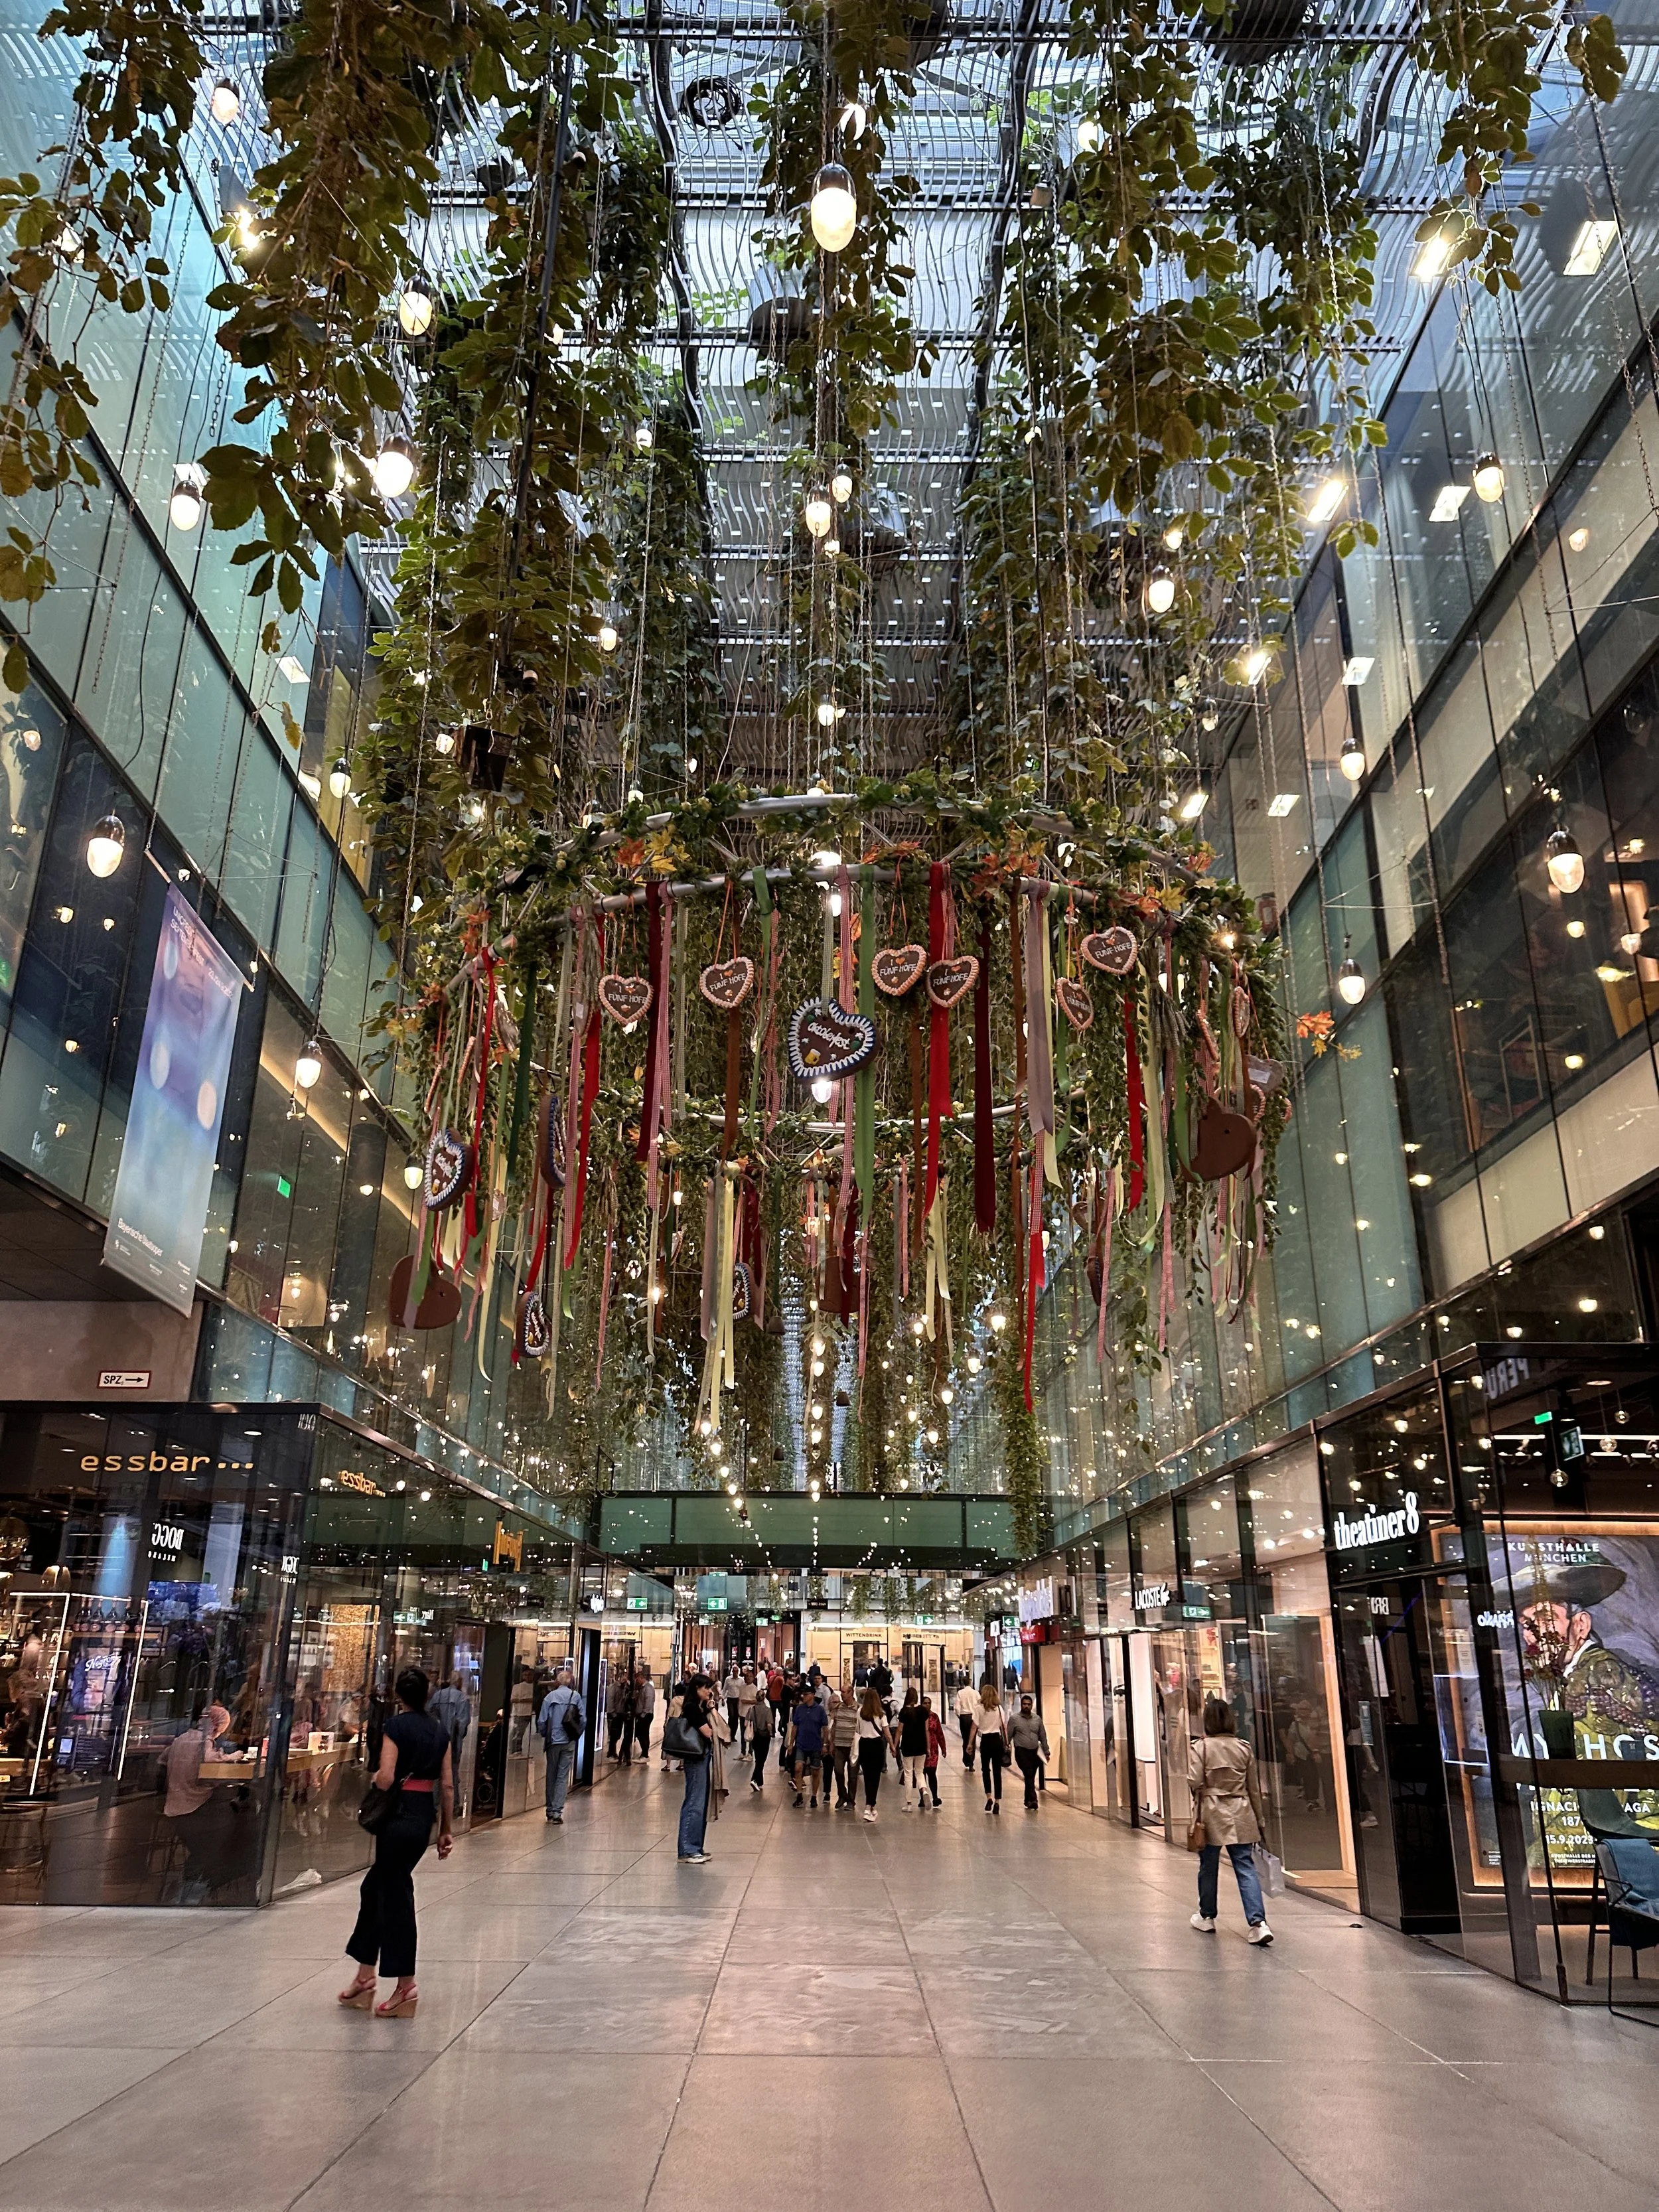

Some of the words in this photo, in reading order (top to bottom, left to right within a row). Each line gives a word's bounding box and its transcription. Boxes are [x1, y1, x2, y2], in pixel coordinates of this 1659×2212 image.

[1135, 1585, 1161, 1610] LACOSTE
[1511, 1733, 1659, 1761] MYHOS
[1530, 1801, 1579, 1812] IGNACI
